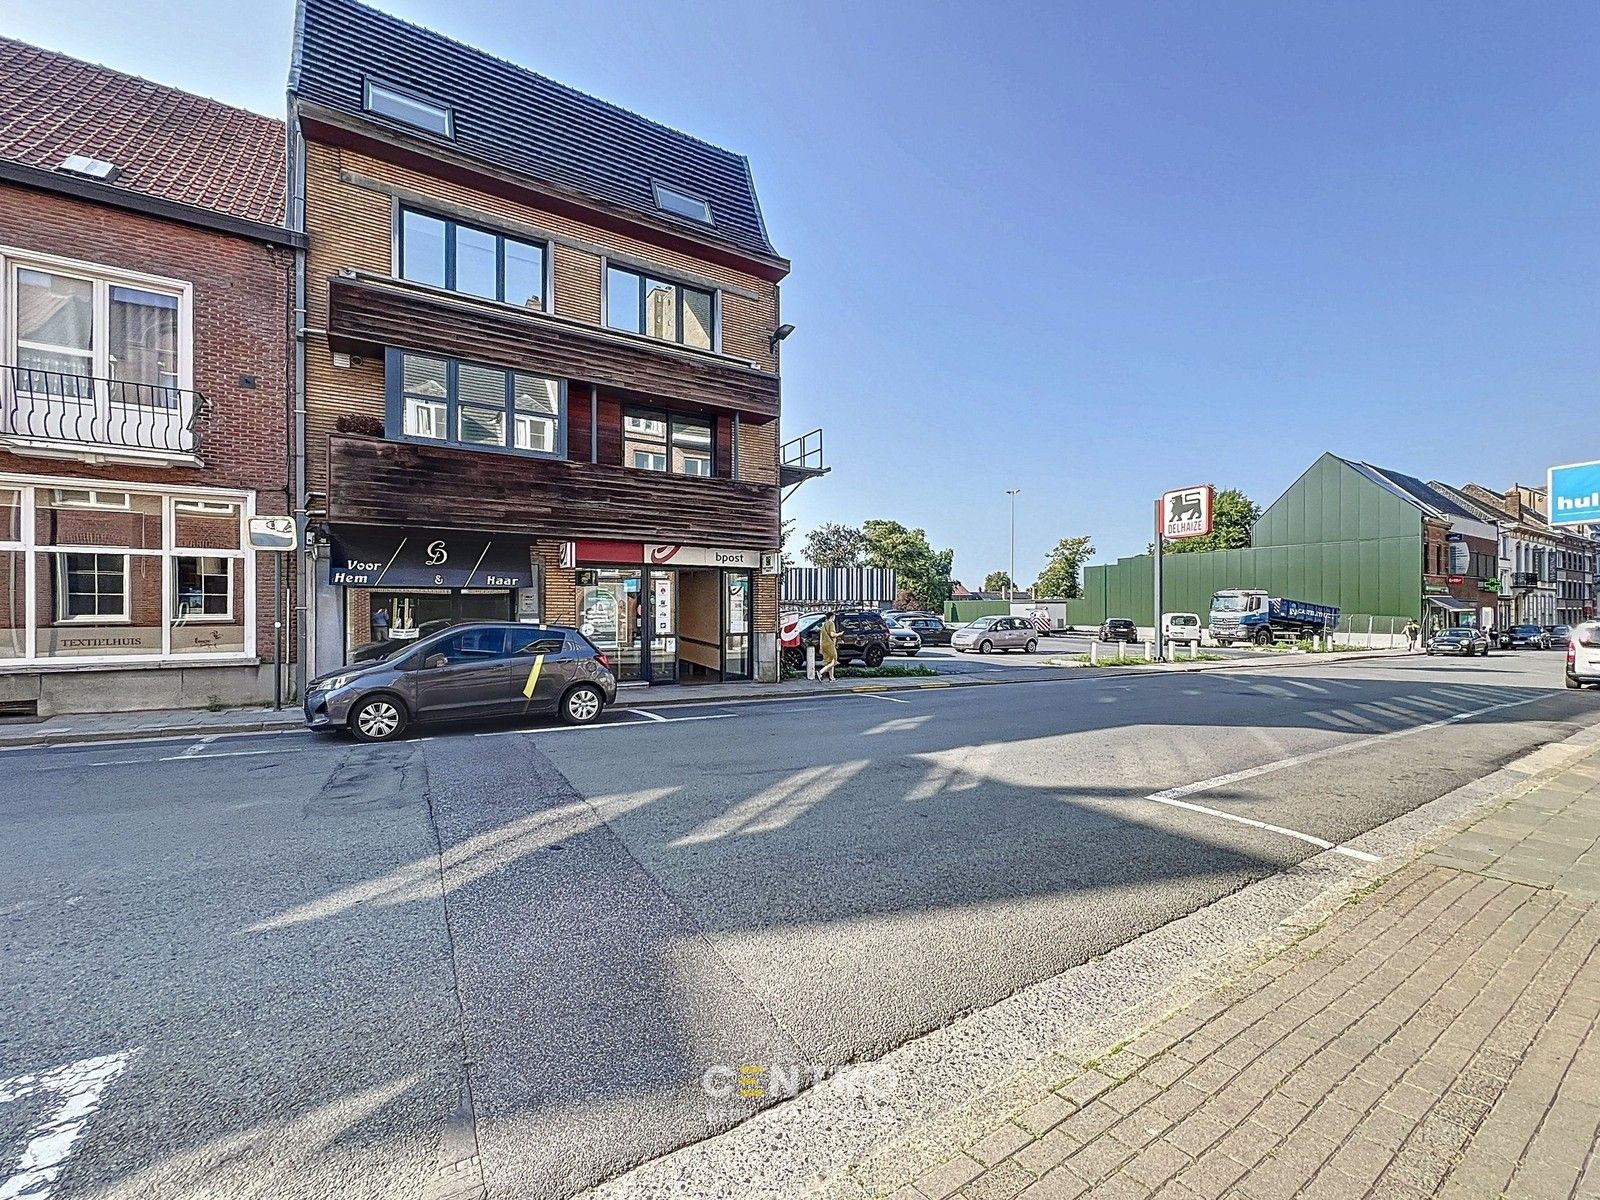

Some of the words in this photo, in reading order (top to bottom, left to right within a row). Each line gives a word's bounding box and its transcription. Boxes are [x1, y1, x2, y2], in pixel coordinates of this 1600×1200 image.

[1168, 521, 1202, 534] DELHAIZE
[715, 552, 744, 564] bpost
[347, 560, 382, 571] Voor
[334, 572, 368, 583] Hem
[434, 574, 444, 585] &
[486, 575, 519, 586] Haar
[61, 637, 142, 647] TEXTIELHUIS
